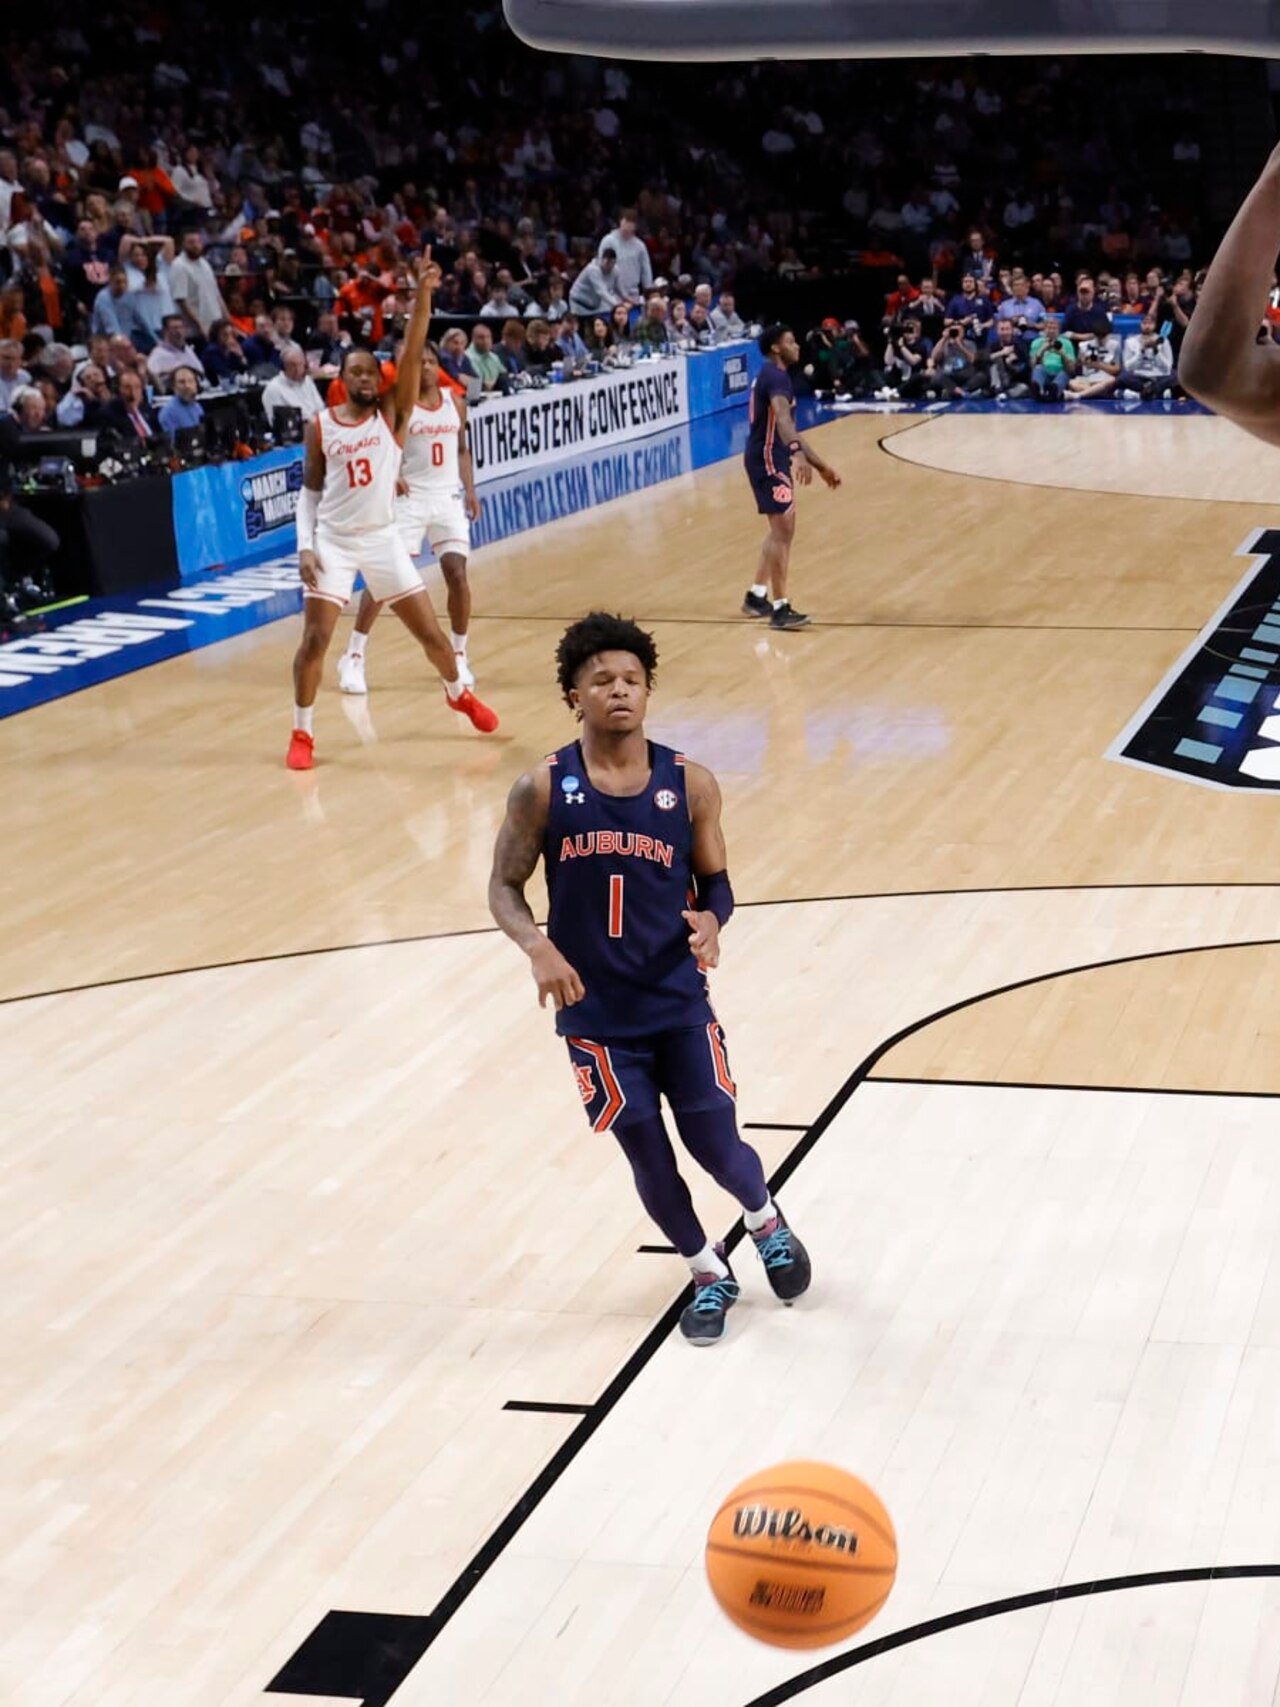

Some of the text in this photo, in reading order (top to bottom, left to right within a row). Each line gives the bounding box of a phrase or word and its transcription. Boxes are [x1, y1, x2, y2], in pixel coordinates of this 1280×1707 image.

[589, 371, 680, 436] CONFERENCE
[346, 458, 373, 489] 13
[432, 443, 443, 466] 0
[0, 612, 196, 687] AREN
[560, 831, 674, 868] AUBURN
[608, 874, 624, 938] 1
[734, 1506, 859, 1555] Wilson
